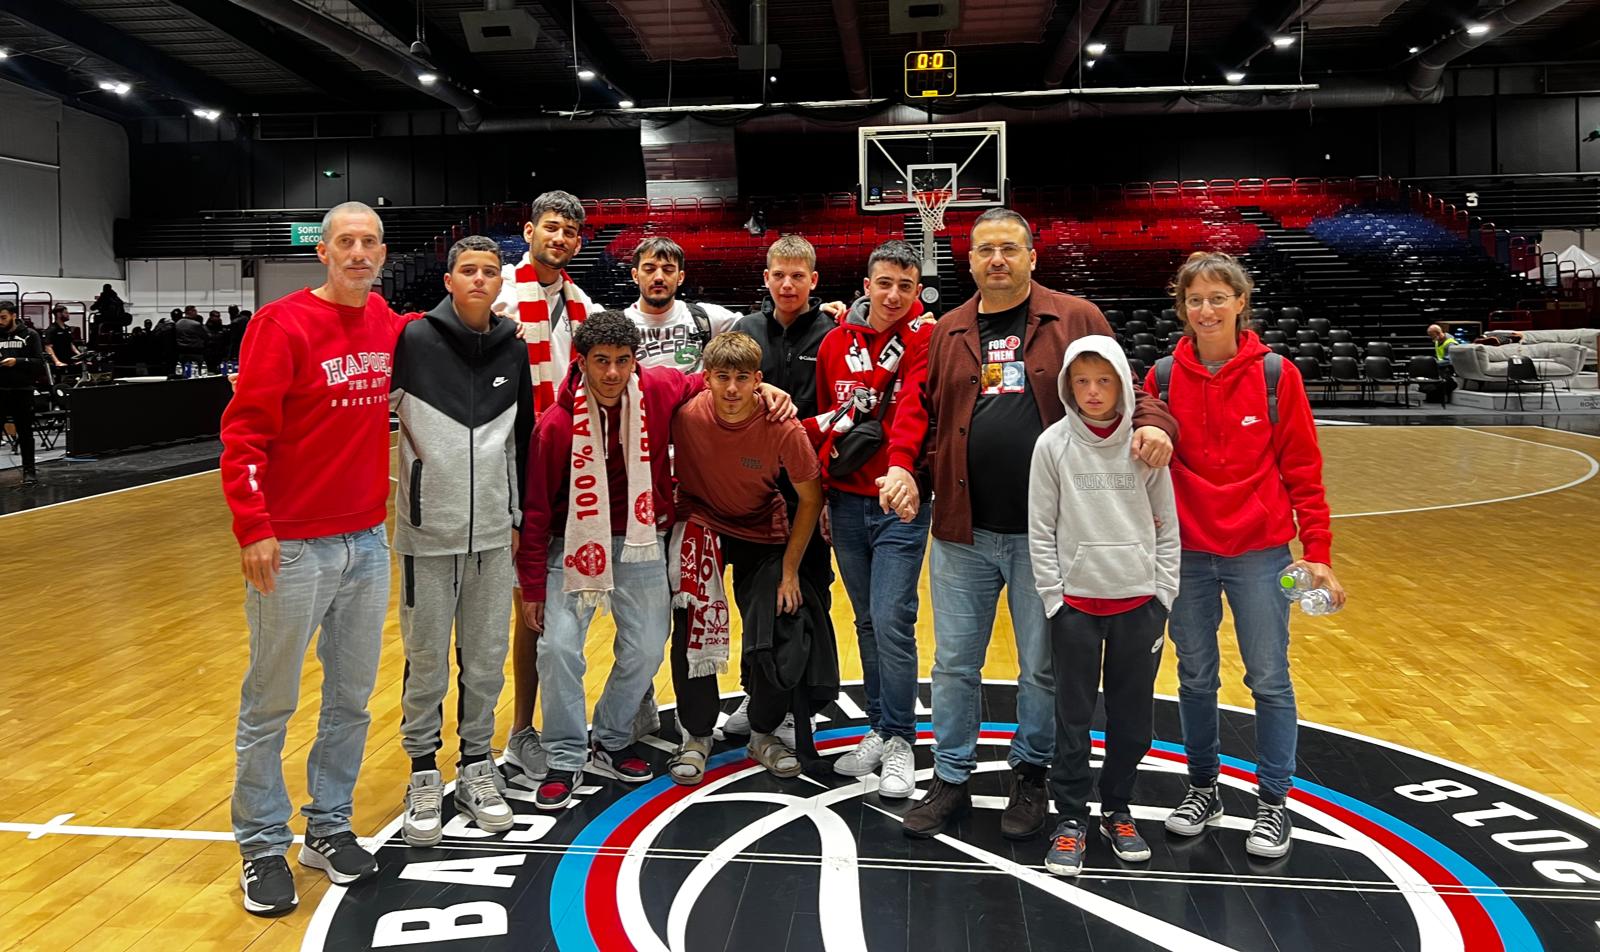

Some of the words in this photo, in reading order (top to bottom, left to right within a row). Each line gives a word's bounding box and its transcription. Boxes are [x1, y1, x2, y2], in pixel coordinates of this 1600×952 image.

[917, 53, 944, 69] 0:0
[297, 226, 322, 234] SORTI
[299, 235, 322, 243] SECO
[988, 339, 1006, 350] FOR
[988, 350, 1015, 361] THEM
[574, 474, 599, 520] 100
[688, 530, 714, 650] HAPOE
[1394, 779, 1600, 884] 2018
